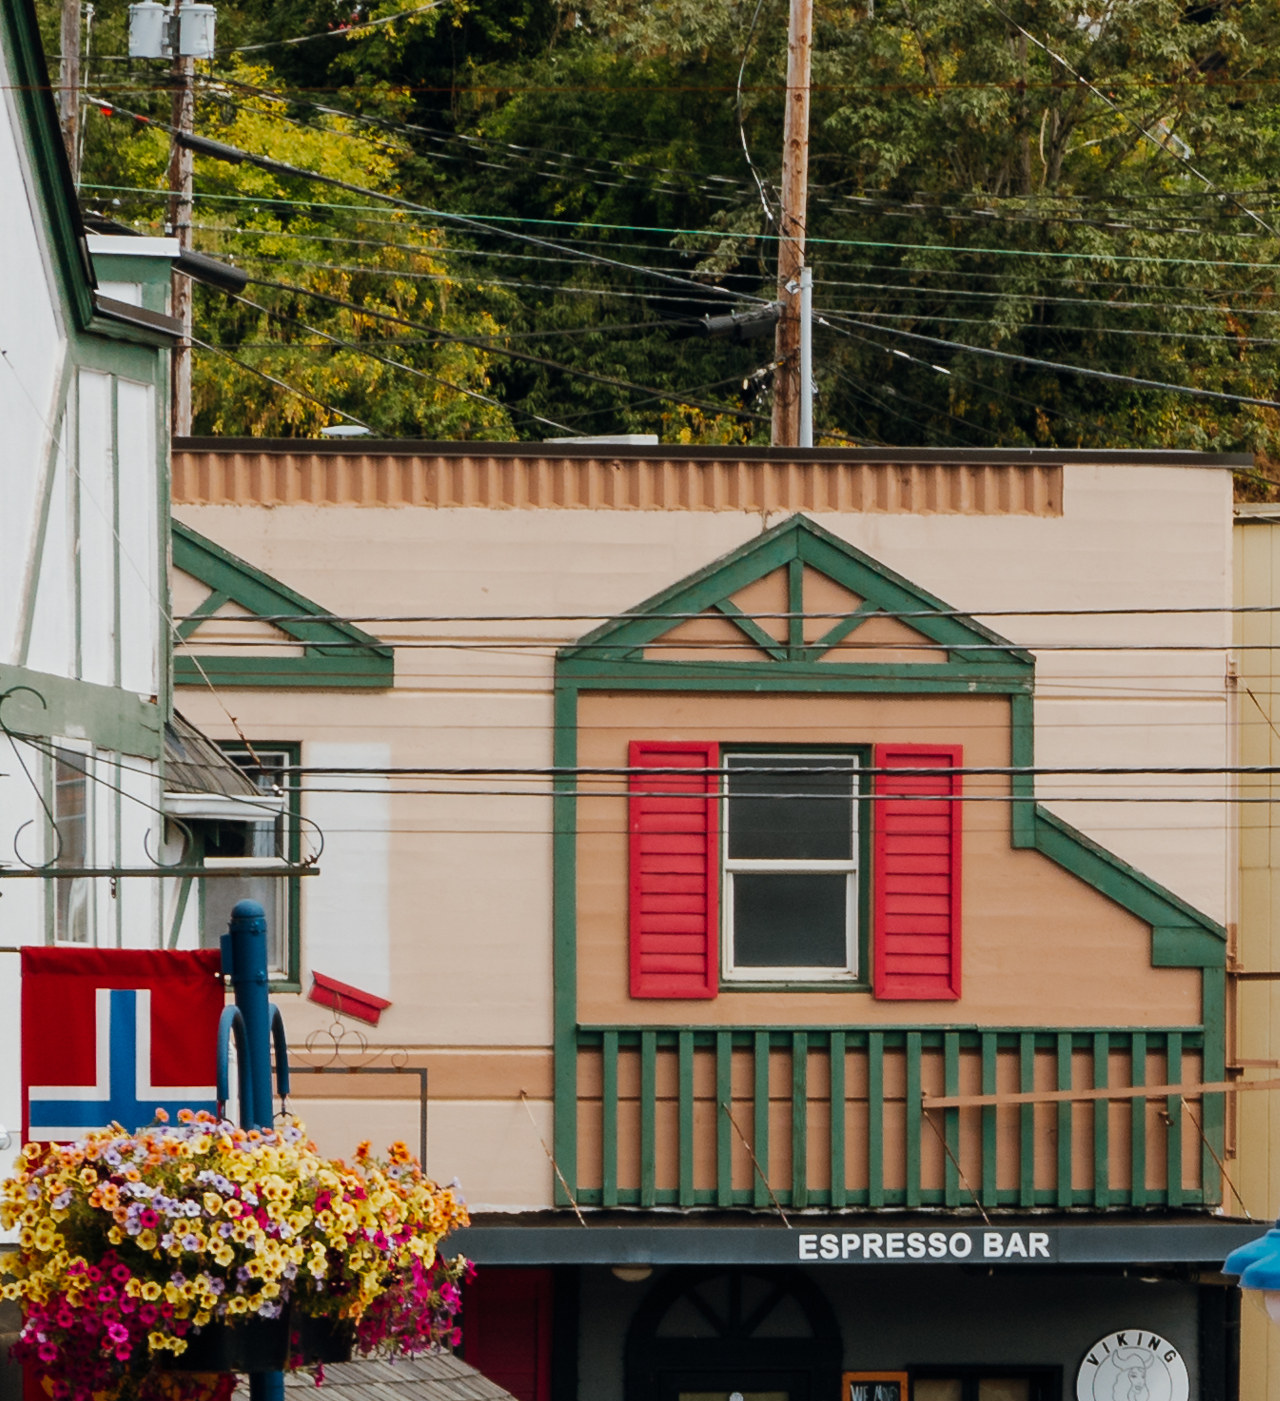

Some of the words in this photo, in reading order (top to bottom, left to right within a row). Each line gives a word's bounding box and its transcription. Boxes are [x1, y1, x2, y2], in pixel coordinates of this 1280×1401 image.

[798, 1231, 973, 1260] ESPRESSO
[983, 1231, 1051, 1259] BAR
[1086, 1332, 1177, 1367] VIKING
